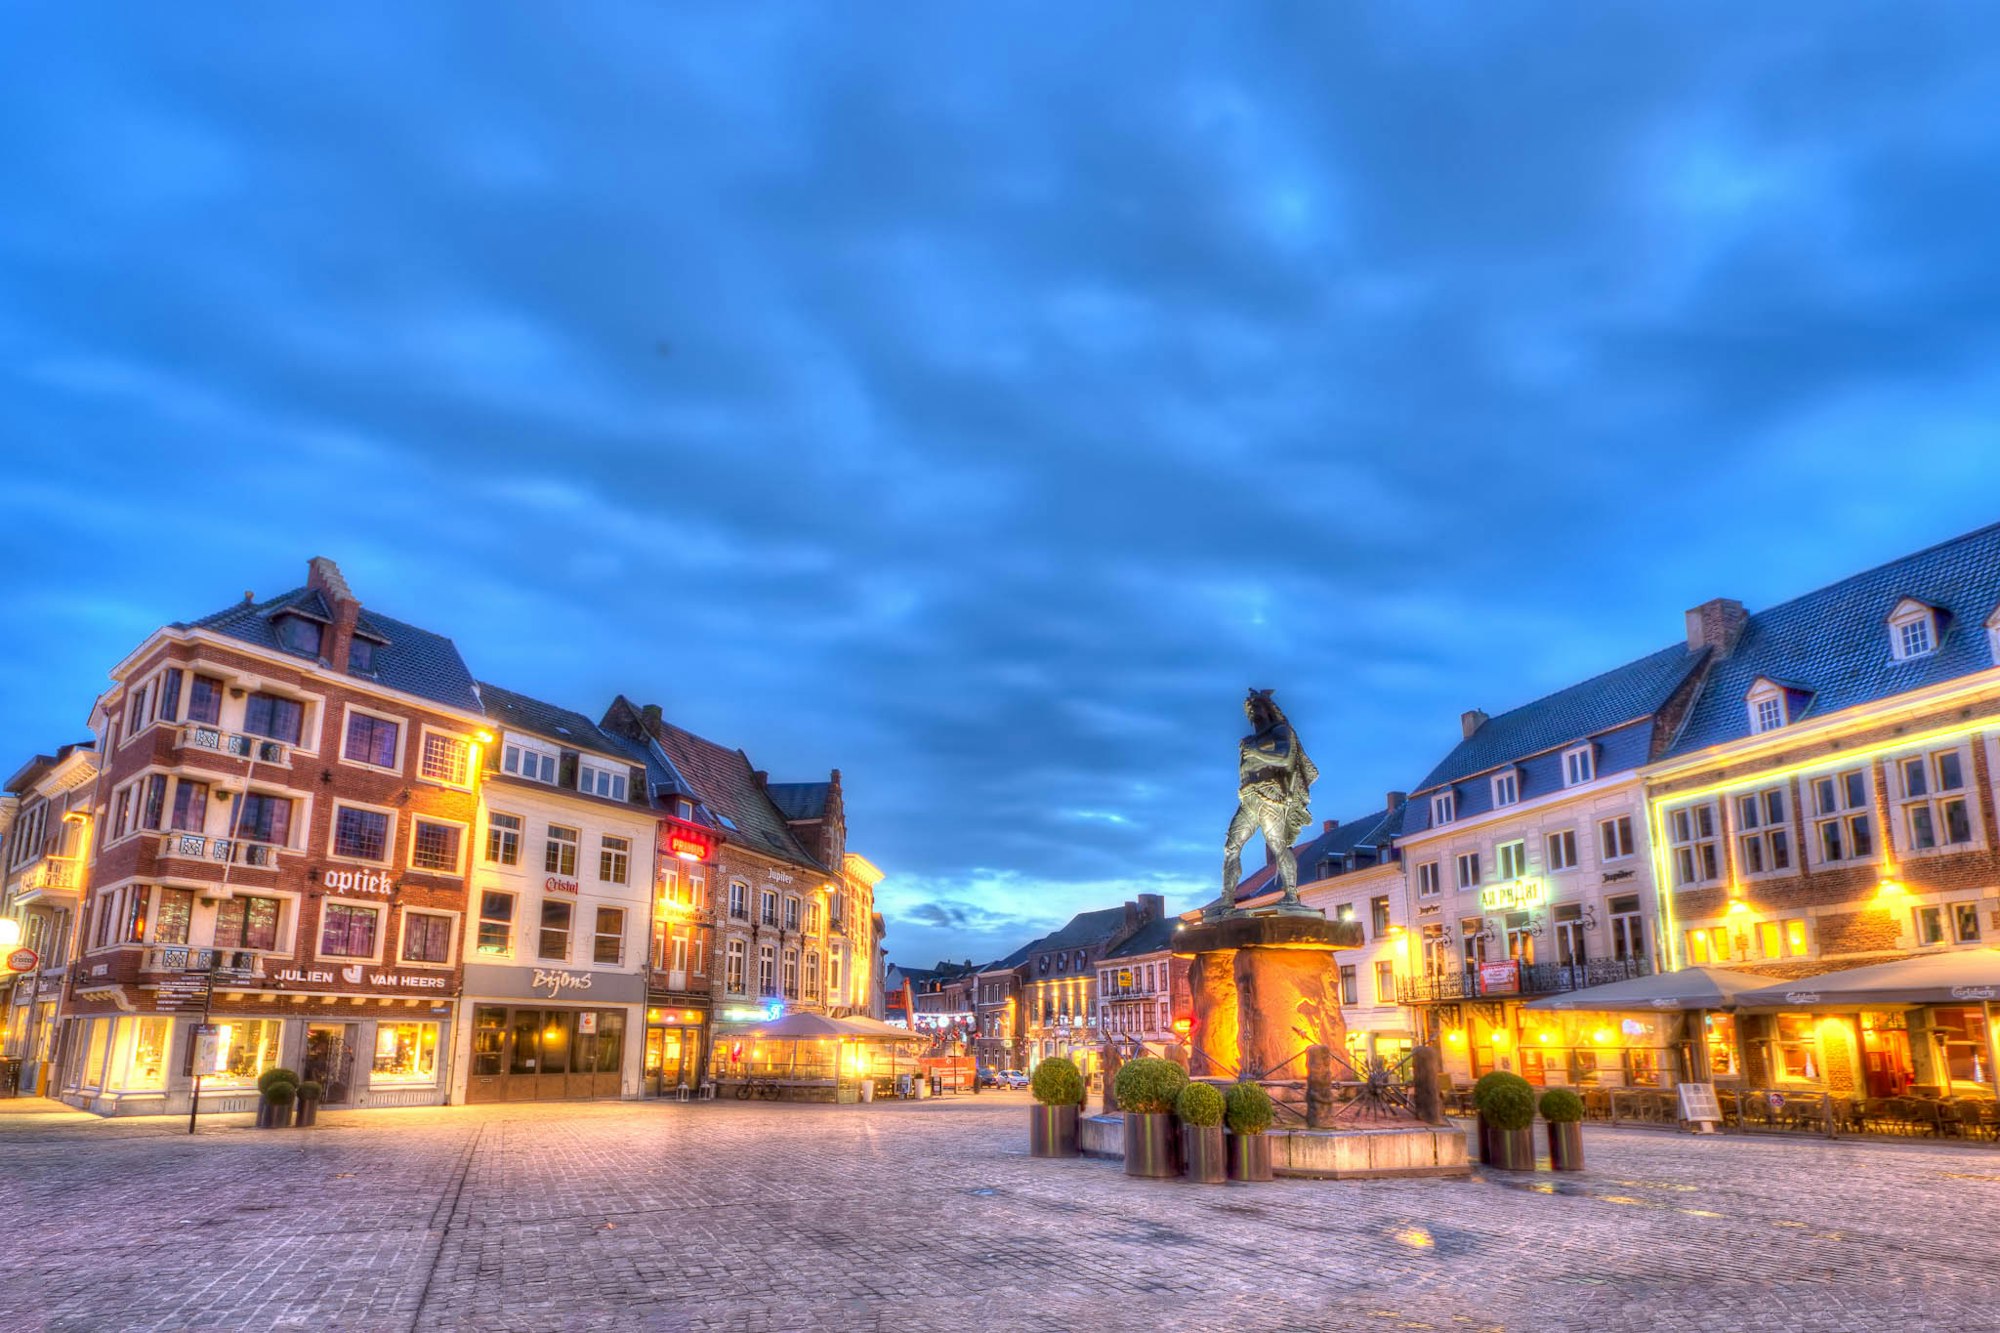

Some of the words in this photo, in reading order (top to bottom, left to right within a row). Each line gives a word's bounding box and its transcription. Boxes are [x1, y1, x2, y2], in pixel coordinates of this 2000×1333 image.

[324, 869, 392, 895] optiek
[545, 877, 579, 895] Cristal
[274, 969, 334, 983] JULIEN
[370, 974, 397, 986] VAN
[401, 976, 446, 988] HEERS
[532, 968, 592, 998] Bijons
